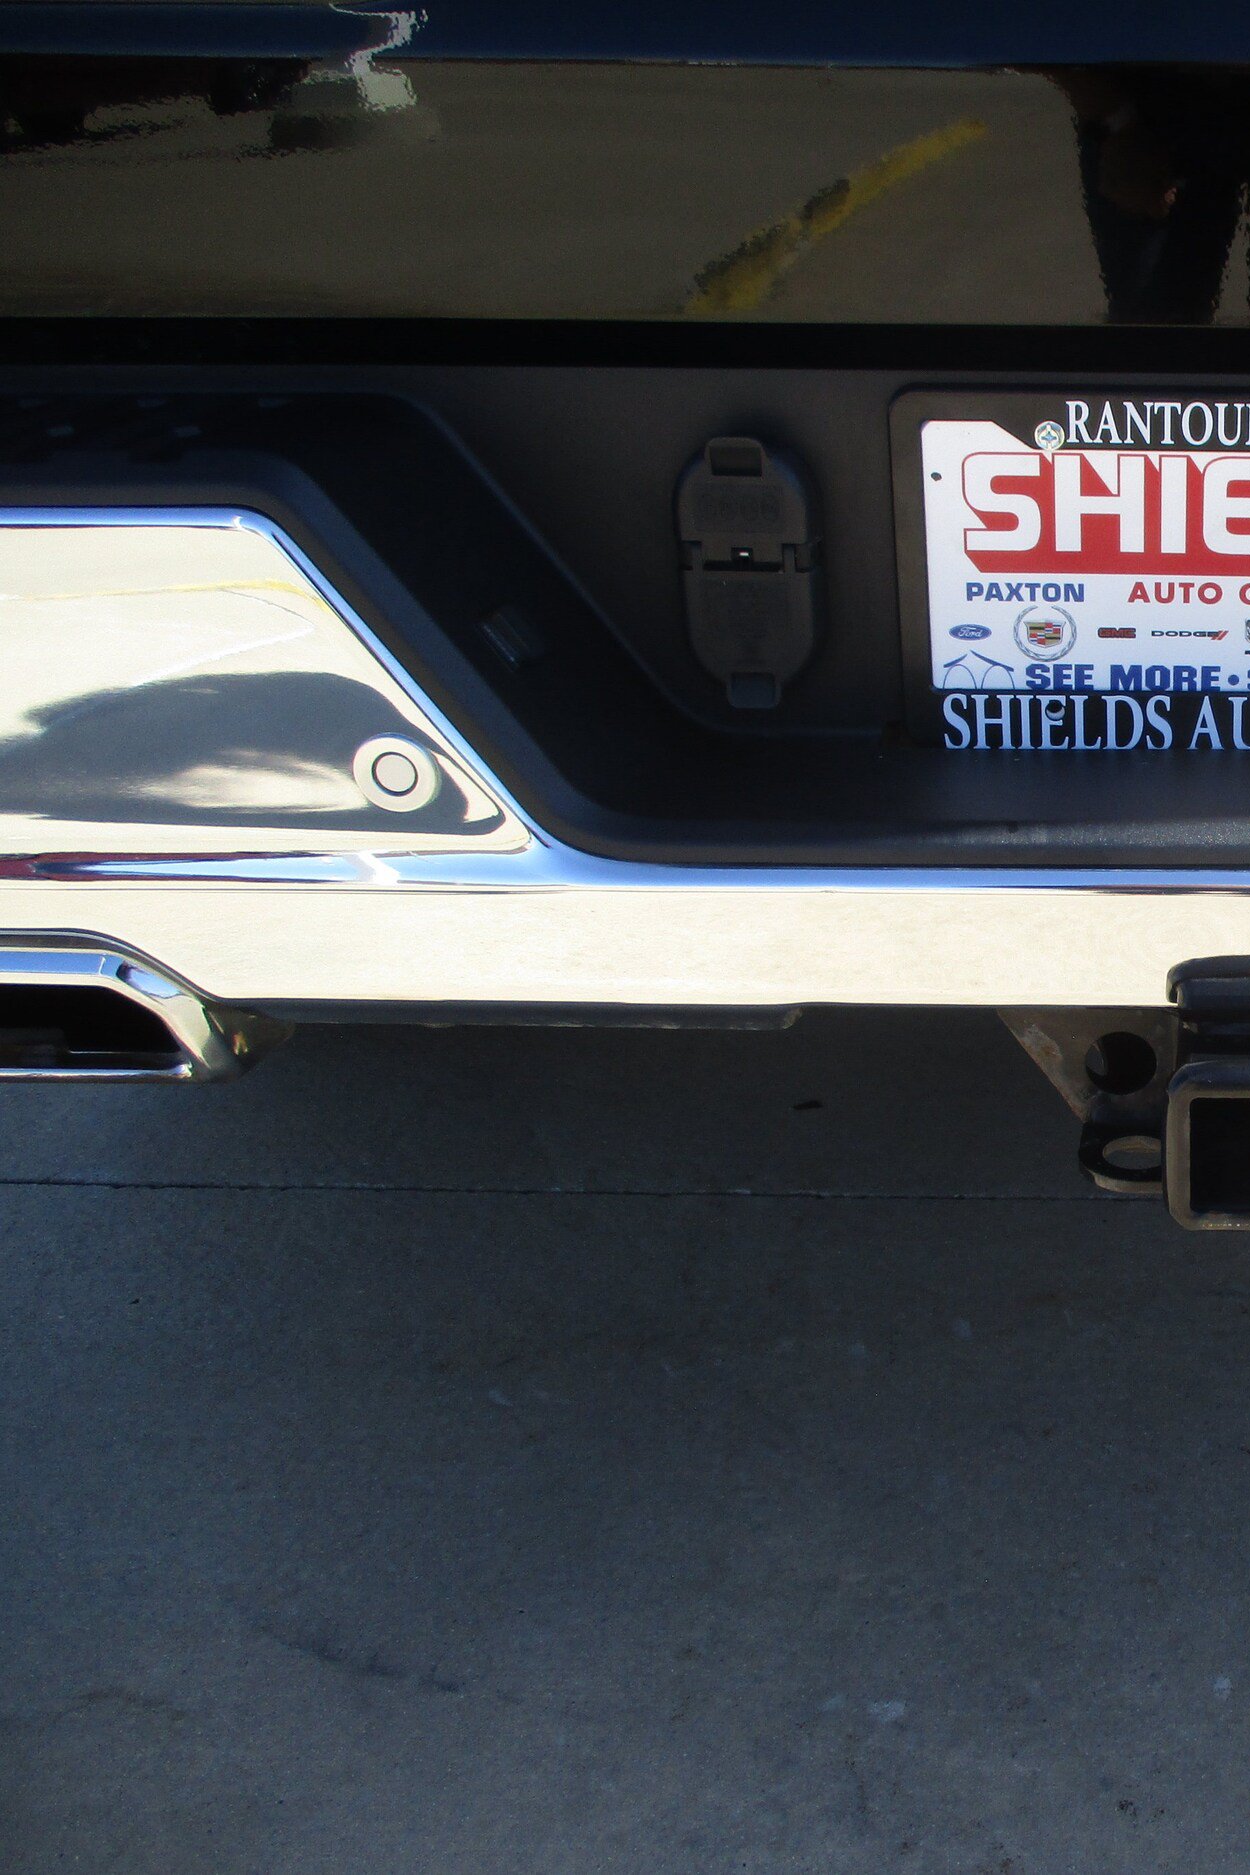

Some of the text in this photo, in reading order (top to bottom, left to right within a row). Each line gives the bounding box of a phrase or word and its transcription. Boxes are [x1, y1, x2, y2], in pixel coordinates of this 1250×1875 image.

[966, 582, 1085, 603] PAXTON
[1127, 581, 1223, 604] AUTO
[1098, 627, 1136, 639] GMC
[1151, 629, 1220, 638] DODGE
[1025, 663, 1094, 690] SEE
[1109, 664, 1221, 692] MORE
[942, 693, 1174, 751] SHIELDS
